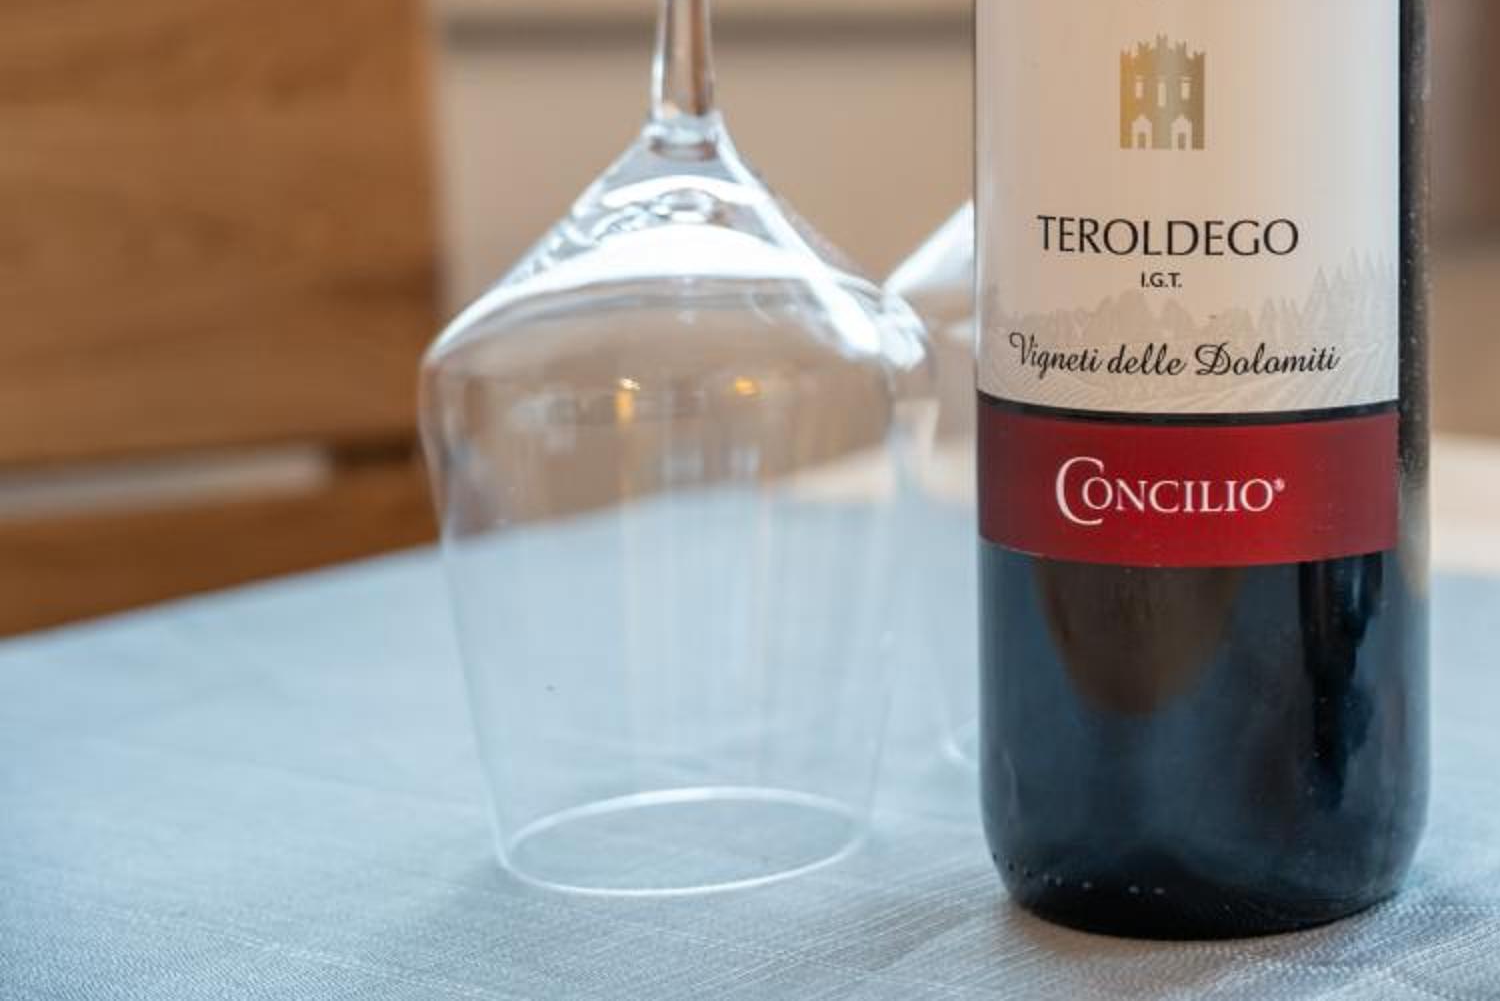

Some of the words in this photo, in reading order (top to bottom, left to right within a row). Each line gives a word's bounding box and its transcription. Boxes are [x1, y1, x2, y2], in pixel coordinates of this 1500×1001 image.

[1037, 215, 1299, 256] TEROLDEGO
[1141, 272, 1182, 288] I.G.T.
[1009, 331, 1103, 380] Vigneti
[1106, 343, 1186, 376] delle
[1195, 342, 1341, 376] Dolomiti
